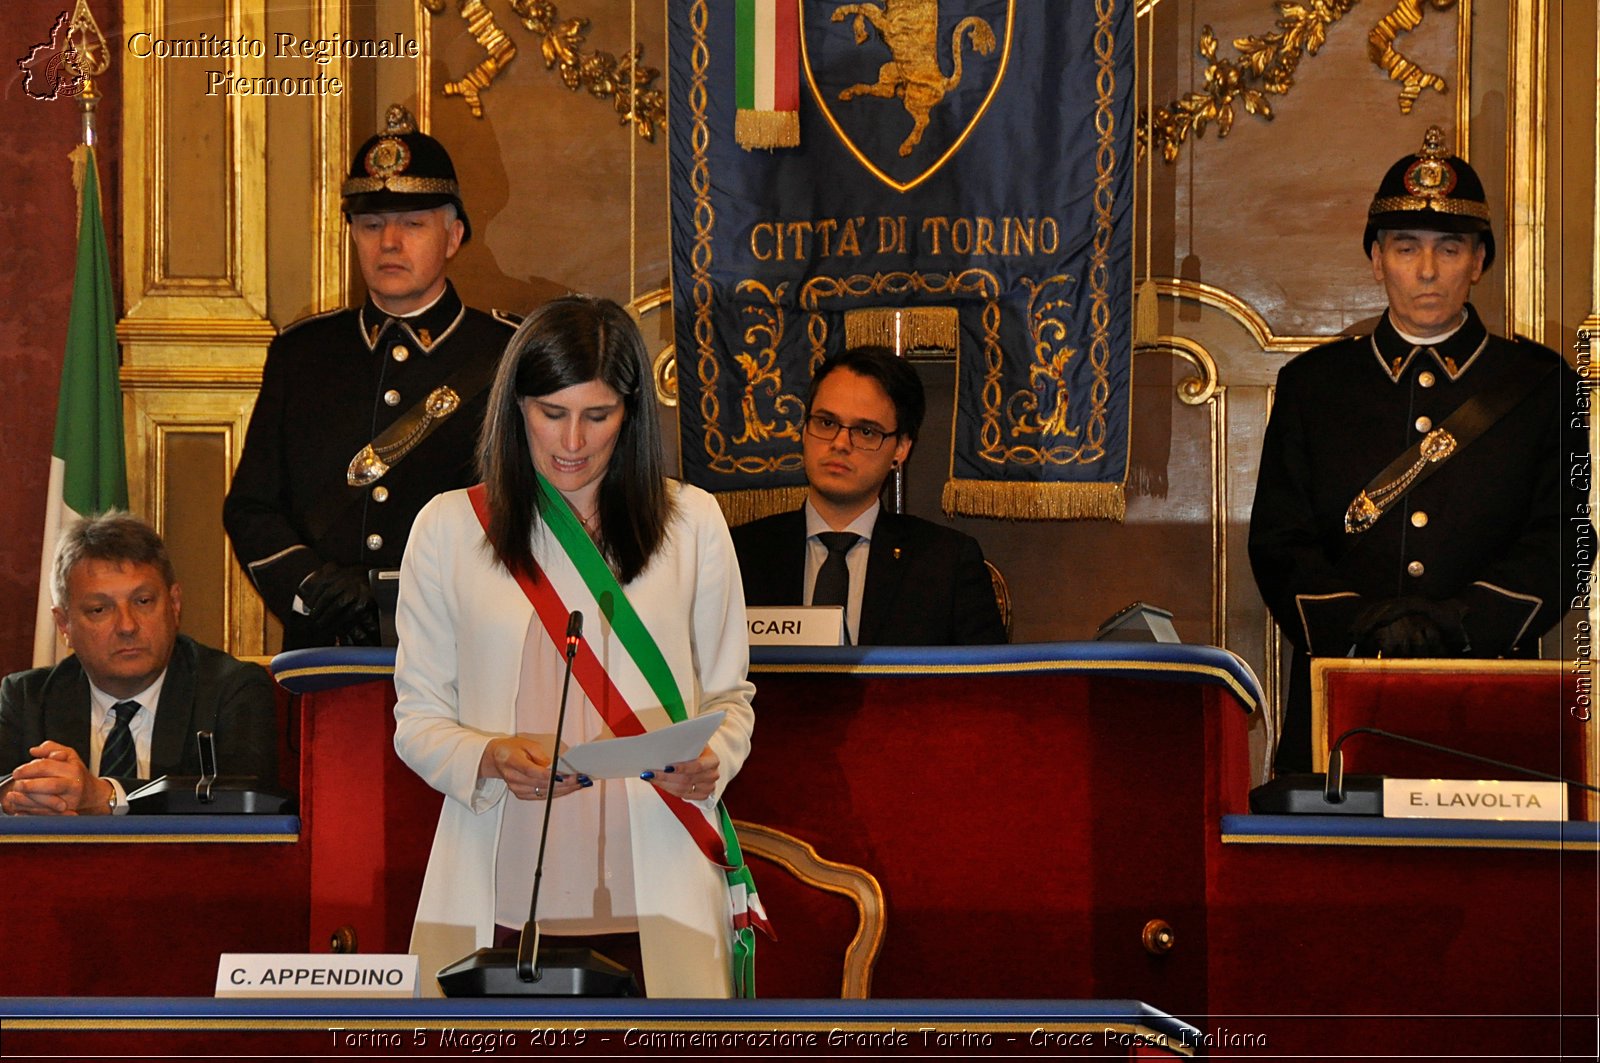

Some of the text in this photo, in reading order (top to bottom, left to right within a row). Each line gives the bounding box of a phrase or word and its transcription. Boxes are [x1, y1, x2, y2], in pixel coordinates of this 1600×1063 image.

[877, 216, 908, 254] DI
[922, 216, 1060, 256] TORINO
[1409, 792, 1542, 809] E. LAVOLTA
[230, 968, 404, 986] C. APPENDINO
